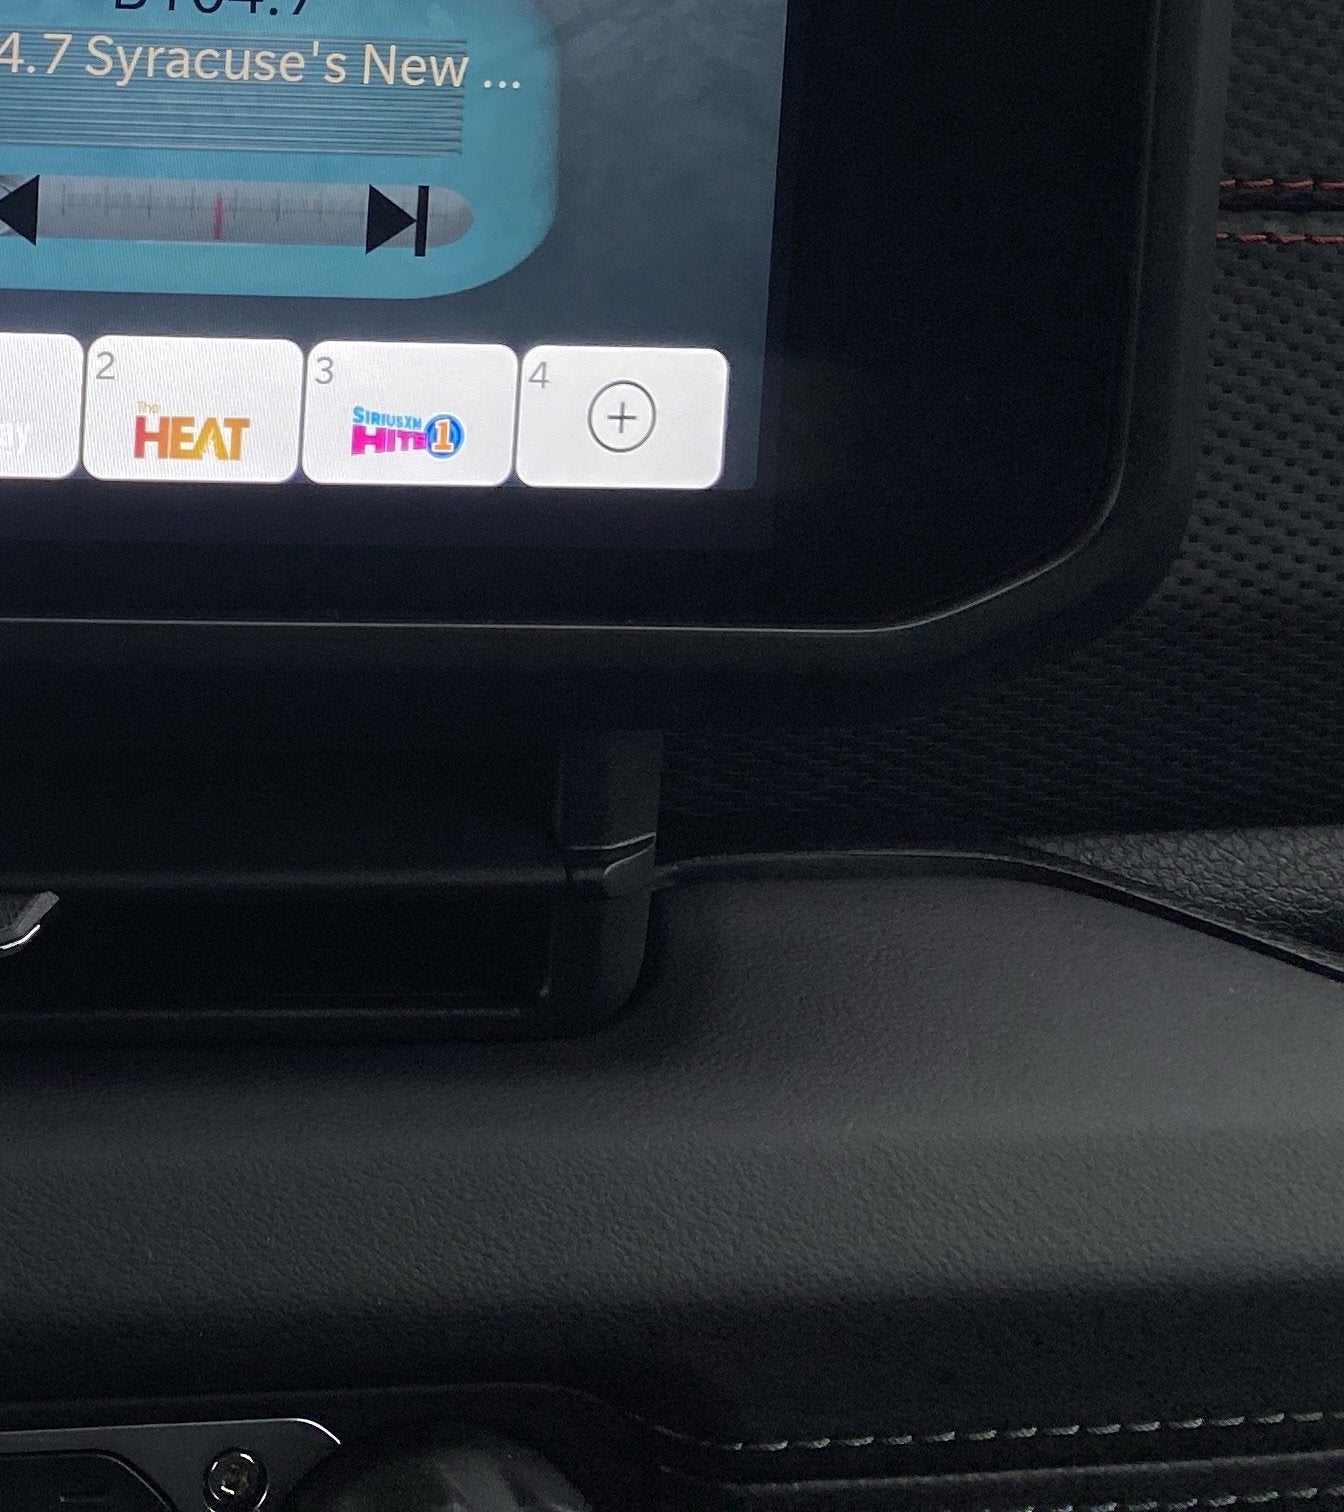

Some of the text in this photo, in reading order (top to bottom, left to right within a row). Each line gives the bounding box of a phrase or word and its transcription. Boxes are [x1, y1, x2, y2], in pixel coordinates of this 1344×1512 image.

[85, 37, 348, 87] Syracuse's
[362, 43, 469, 87] New
[95, 351, 116, 380] 2
[315, 356, 335, 385] 3
[528, 360, 550, 389] 4
[134, 415, 251, 461] HEAT
